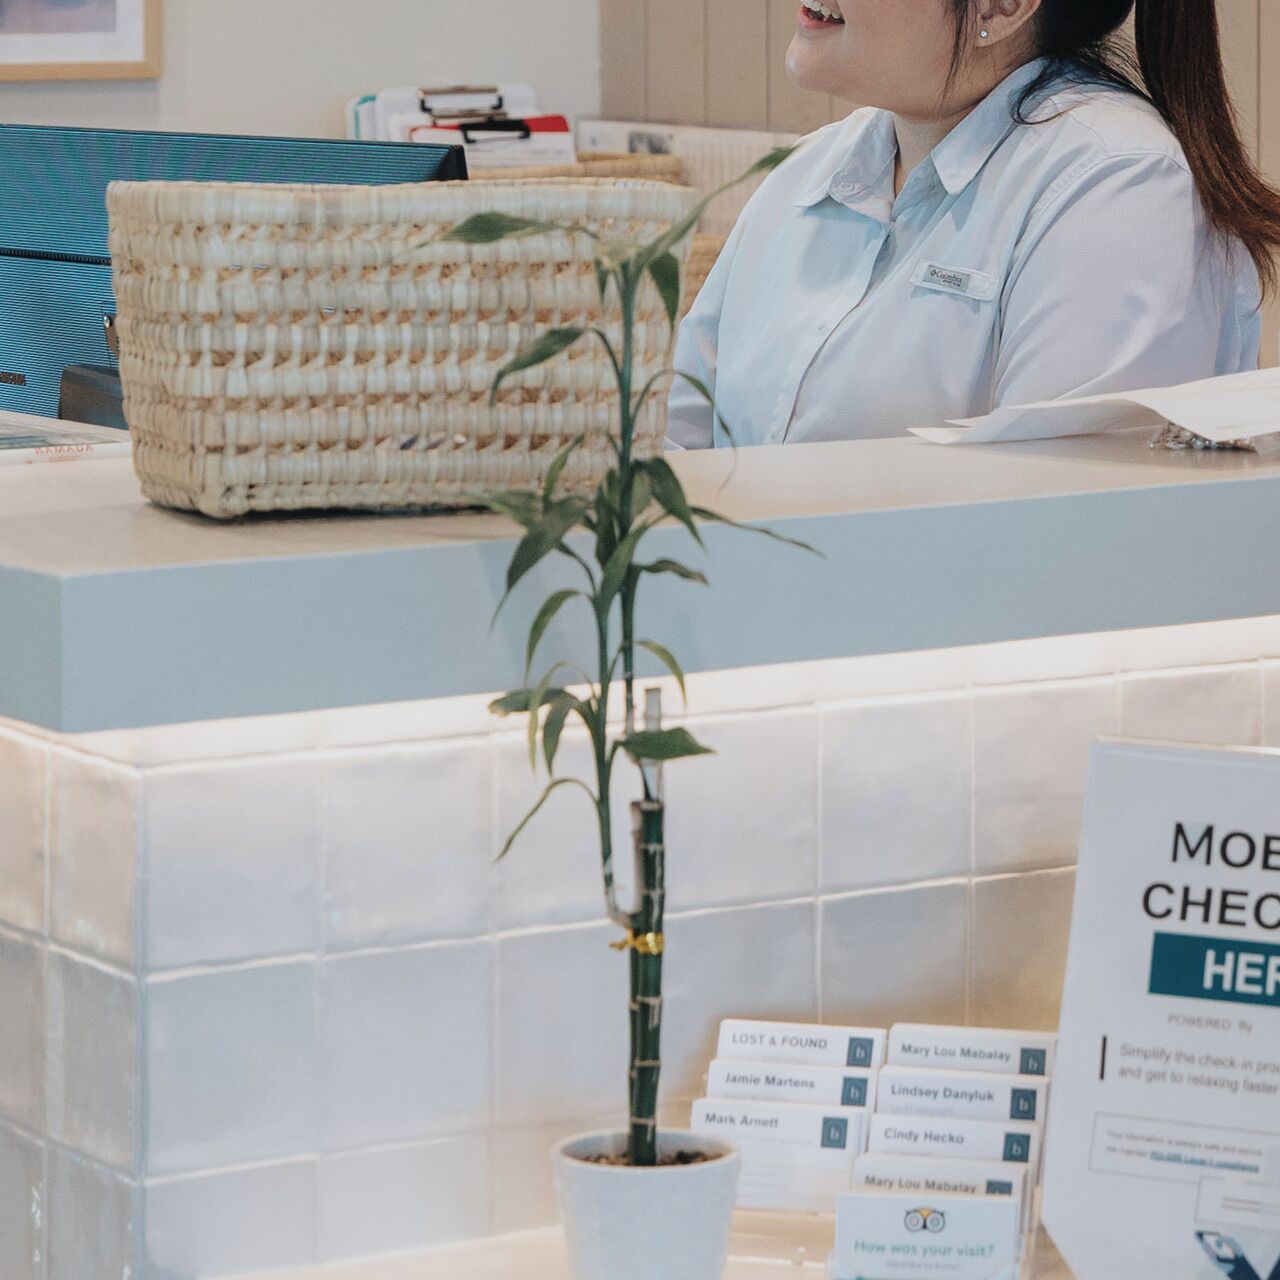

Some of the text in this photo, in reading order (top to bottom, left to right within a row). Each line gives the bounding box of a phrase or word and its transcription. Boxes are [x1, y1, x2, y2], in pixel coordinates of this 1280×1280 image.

[732, 1033, 828, 1050] LOST & FOUND
[901, 1044, 930, 1057] Mary
[934, 1046, 956, 1057] Lou
[1120, 1043, 1171, 1064] Simplify
[1174, 1049, 1196, 1065] the
[1198, 1053, 1254, 1073] check-in
[724, 1072, 816, 1089] Jamie Martens
[1118, 1065, 1279, 1096] and get to relaxing faster
[890, 1085, 995, 1102] Lindsey Danyluk
[705, 1113, 736, 1125] Mark
[884, 1128, 919, 1144] Cindy
[864, 1175, 894, 1190] Mary
[898, 1178, 920, 1190] Lou
[854, 1240, 995, 1258] How was your visit?
